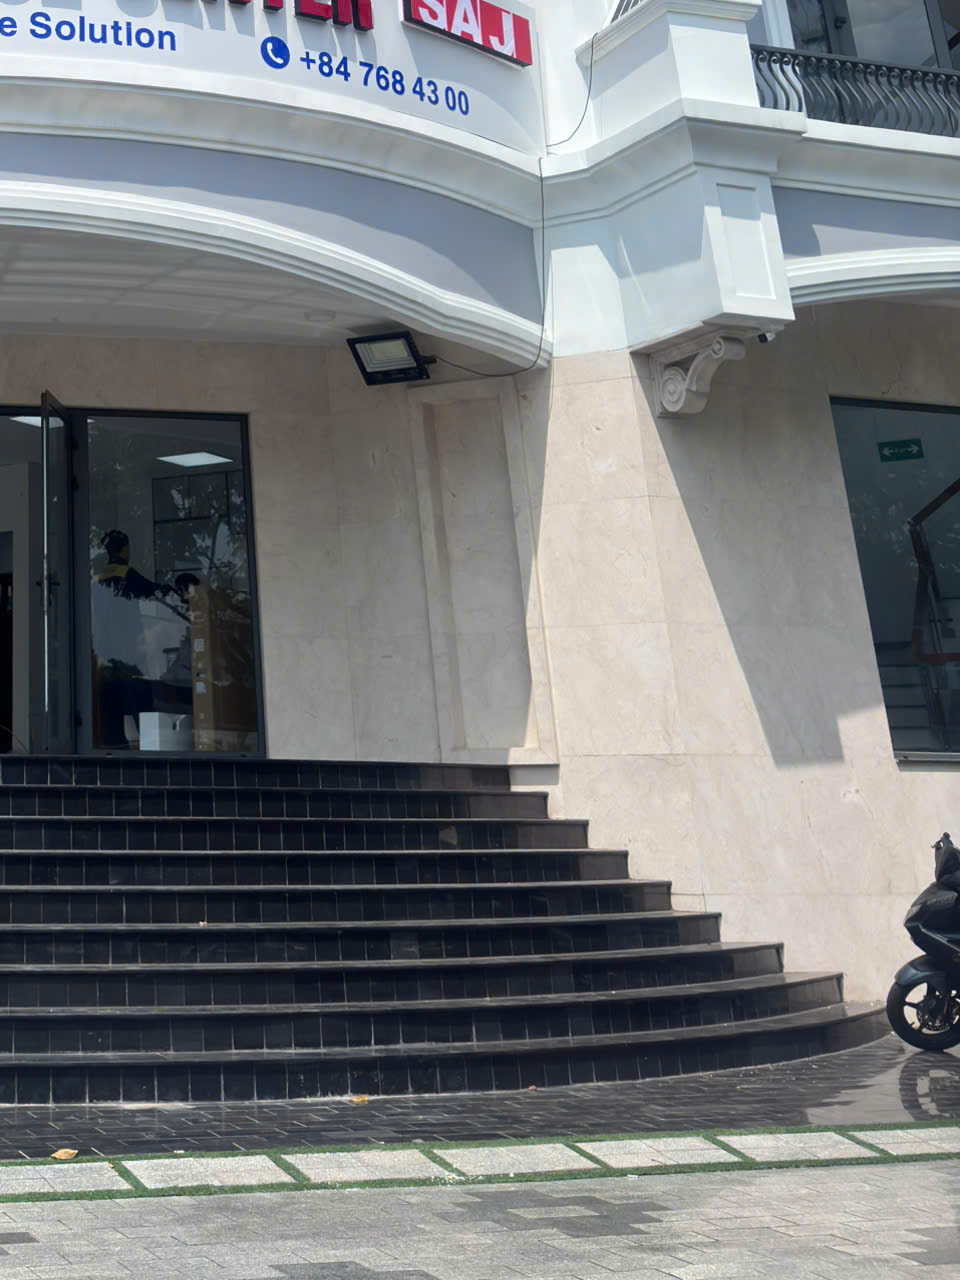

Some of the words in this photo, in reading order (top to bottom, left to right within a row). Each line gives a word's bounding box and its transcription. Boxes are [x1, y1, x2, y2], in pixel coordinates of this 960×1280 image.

[29, 12, 176, 51] Solution
[300, 51, 350, 81] +84
[359, 62, 405, 95] 768
[412, 77, 439, 105] 43
[445, 86, 469, 115] 00
